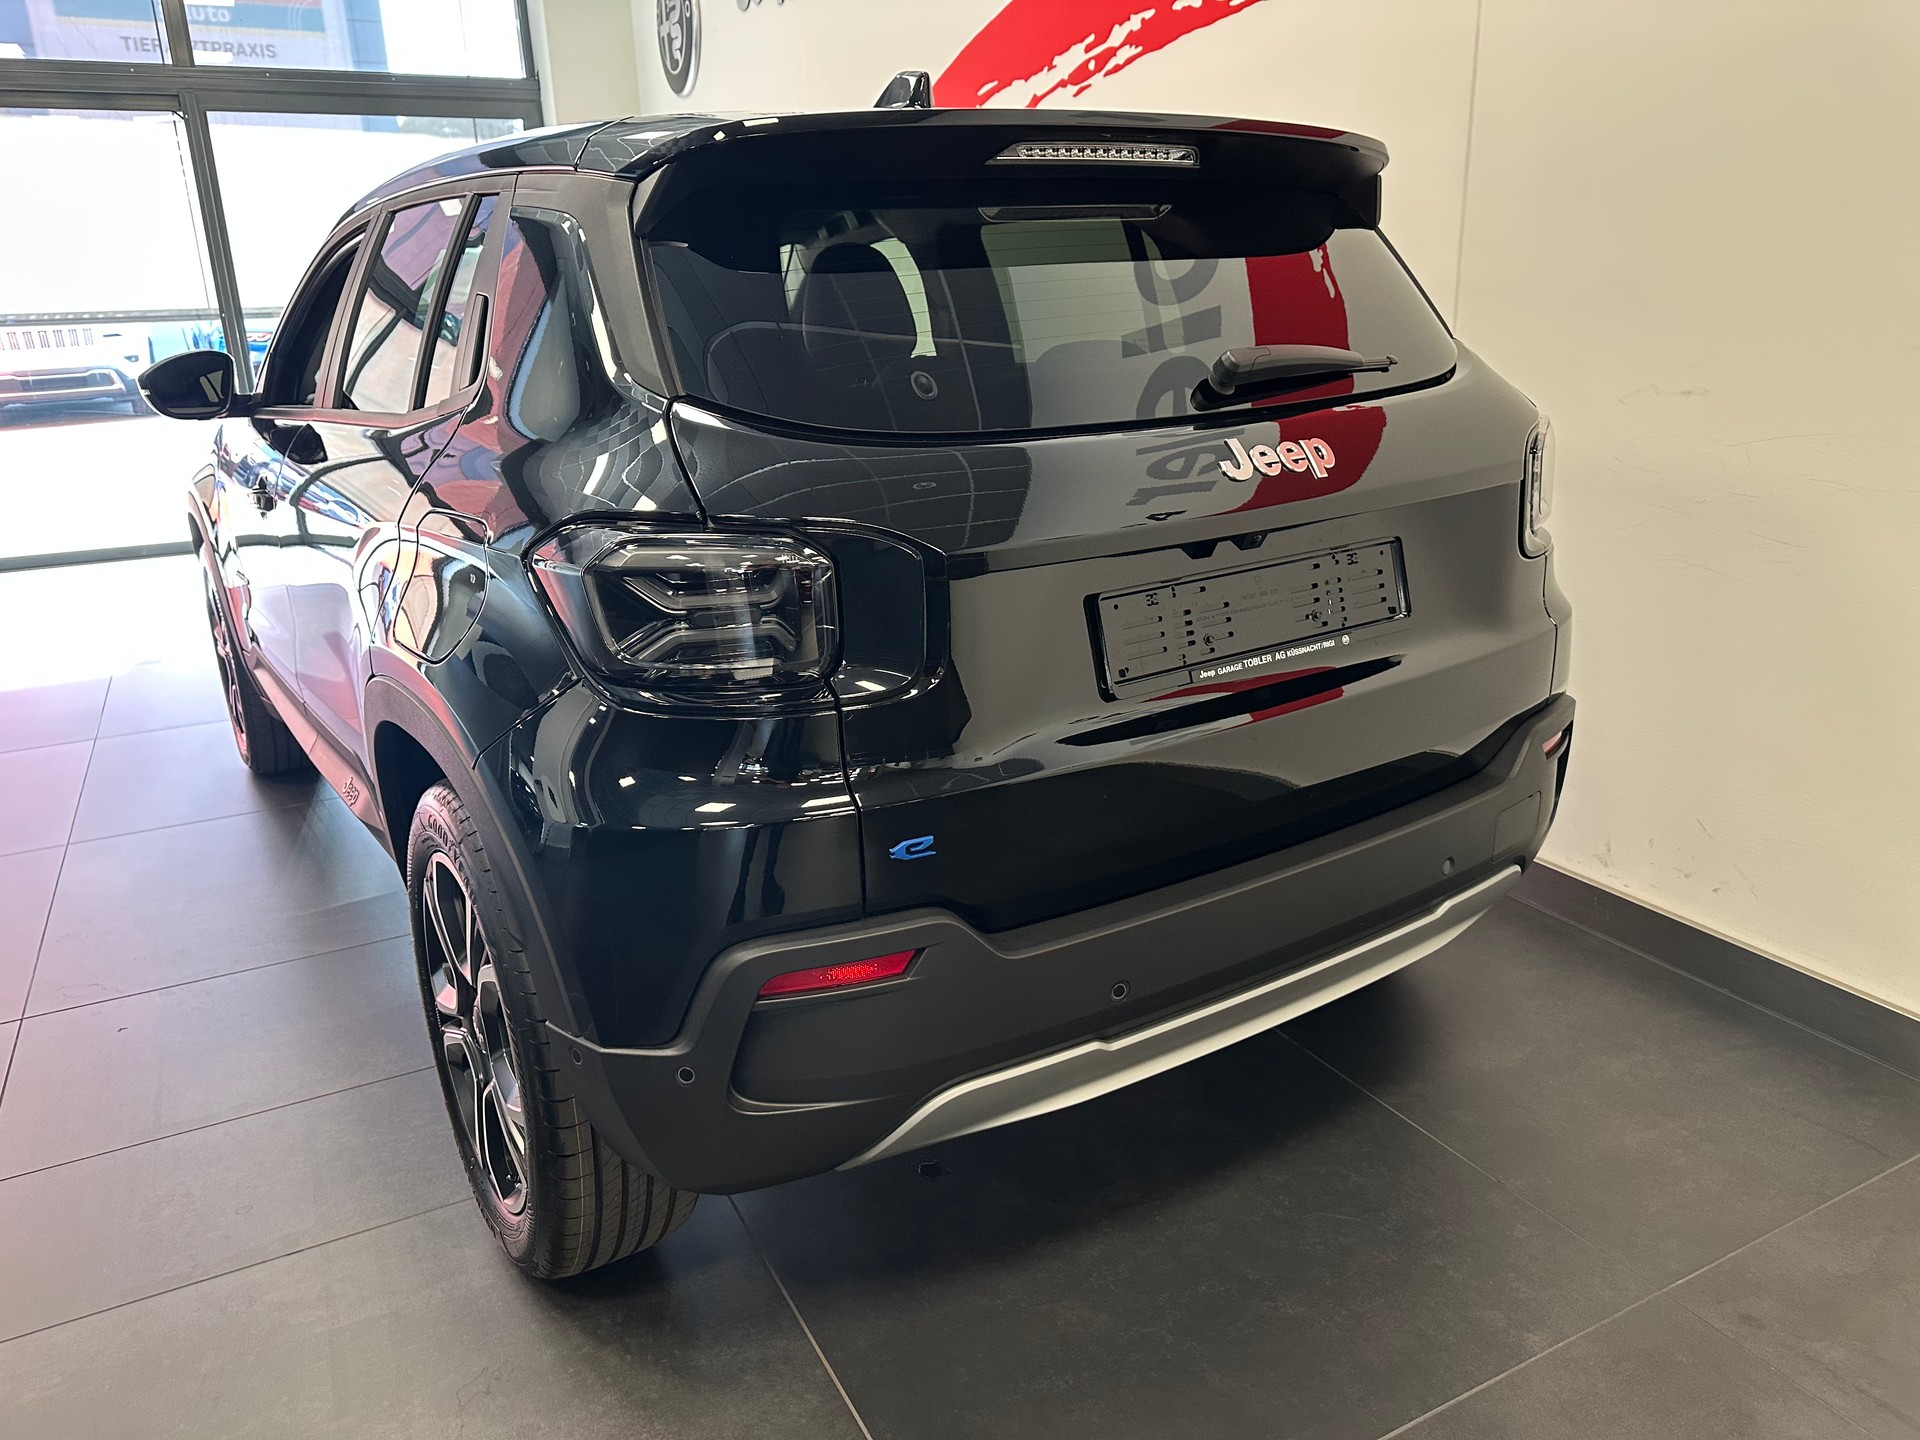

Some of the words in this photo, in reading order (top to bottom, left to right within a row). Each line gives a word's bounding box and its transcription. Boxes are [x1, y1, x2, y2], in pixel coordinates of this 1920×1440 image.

[1218, 437, 1336, 481] Jeep
[1199, 669, 1216, 680] Jeep
[1217, 662, 1243, 675] GARAGE
[1242, 653, 1273, 669] TOBLER
[1275, 650, 1286, 661] AG
[342, 776, 360, 807] Jeep
